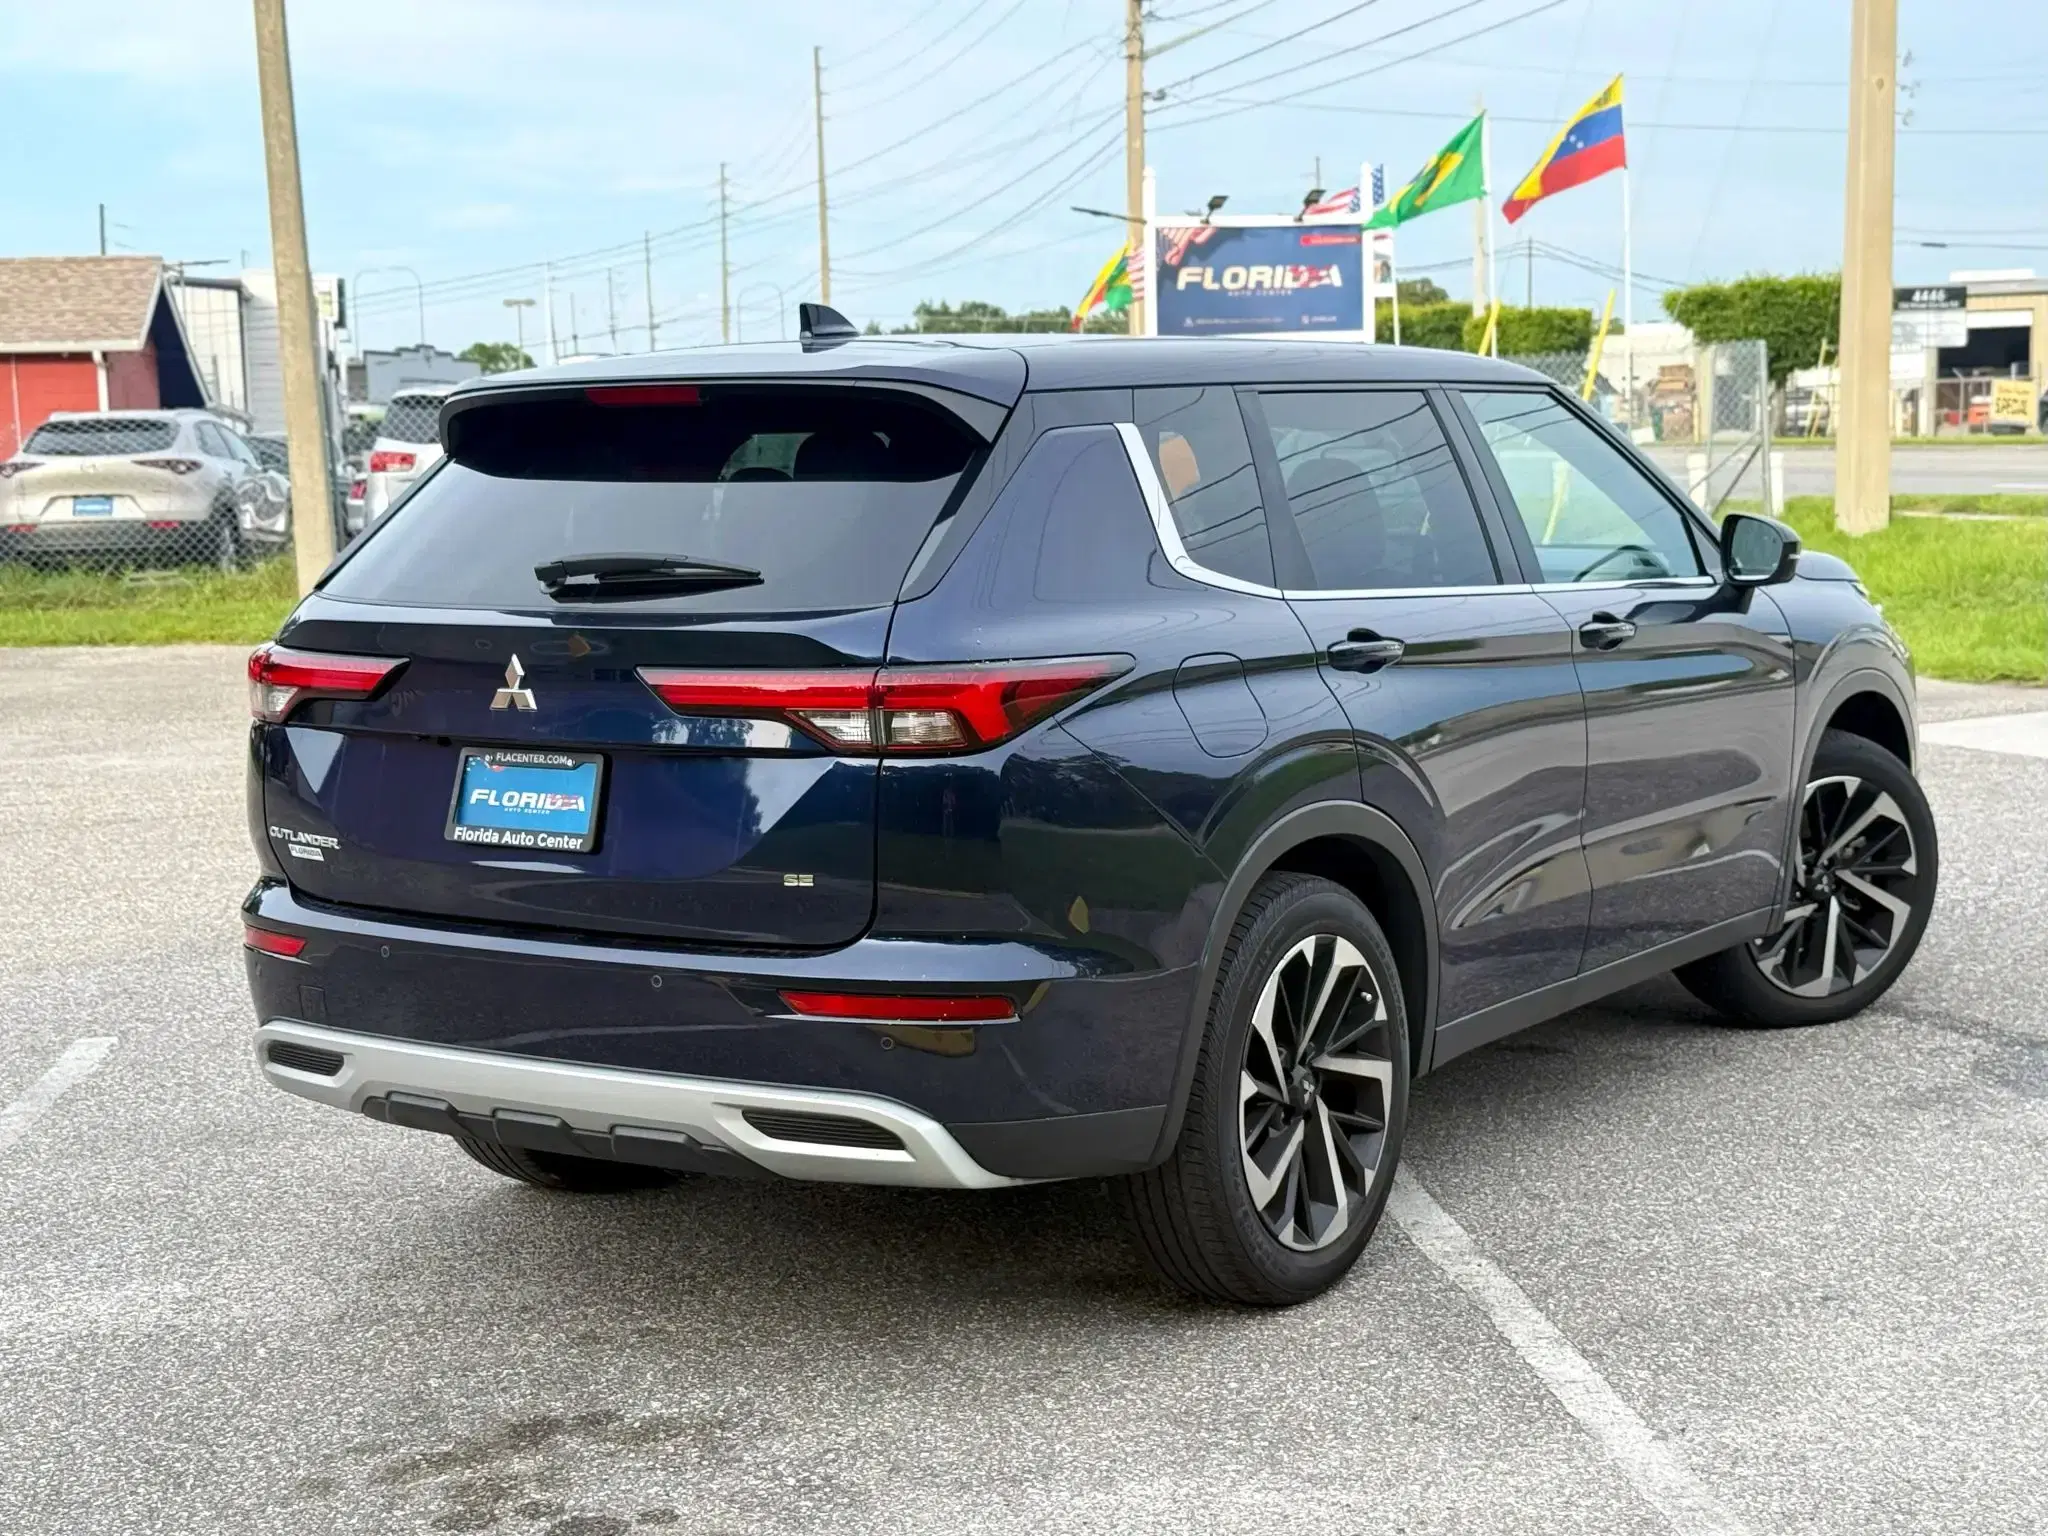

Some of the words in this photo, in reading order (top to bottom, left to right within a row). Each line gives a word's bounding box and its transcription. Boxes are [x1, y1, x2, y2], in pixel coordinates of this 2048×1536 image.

[1177, 265, 1342, 290] FLORIDA
[496, 752, 567, 765] FLACENTER.COM
[470, 788, 585, 812] FLORIDA
[270, 825, 341, 849] OUTLANDER
[454, 827, 499, 844] Florida
[502, 830, 534, 846] Auto
[537, 833, 583, 849] Center
[784, 874, 813, 886] SE
